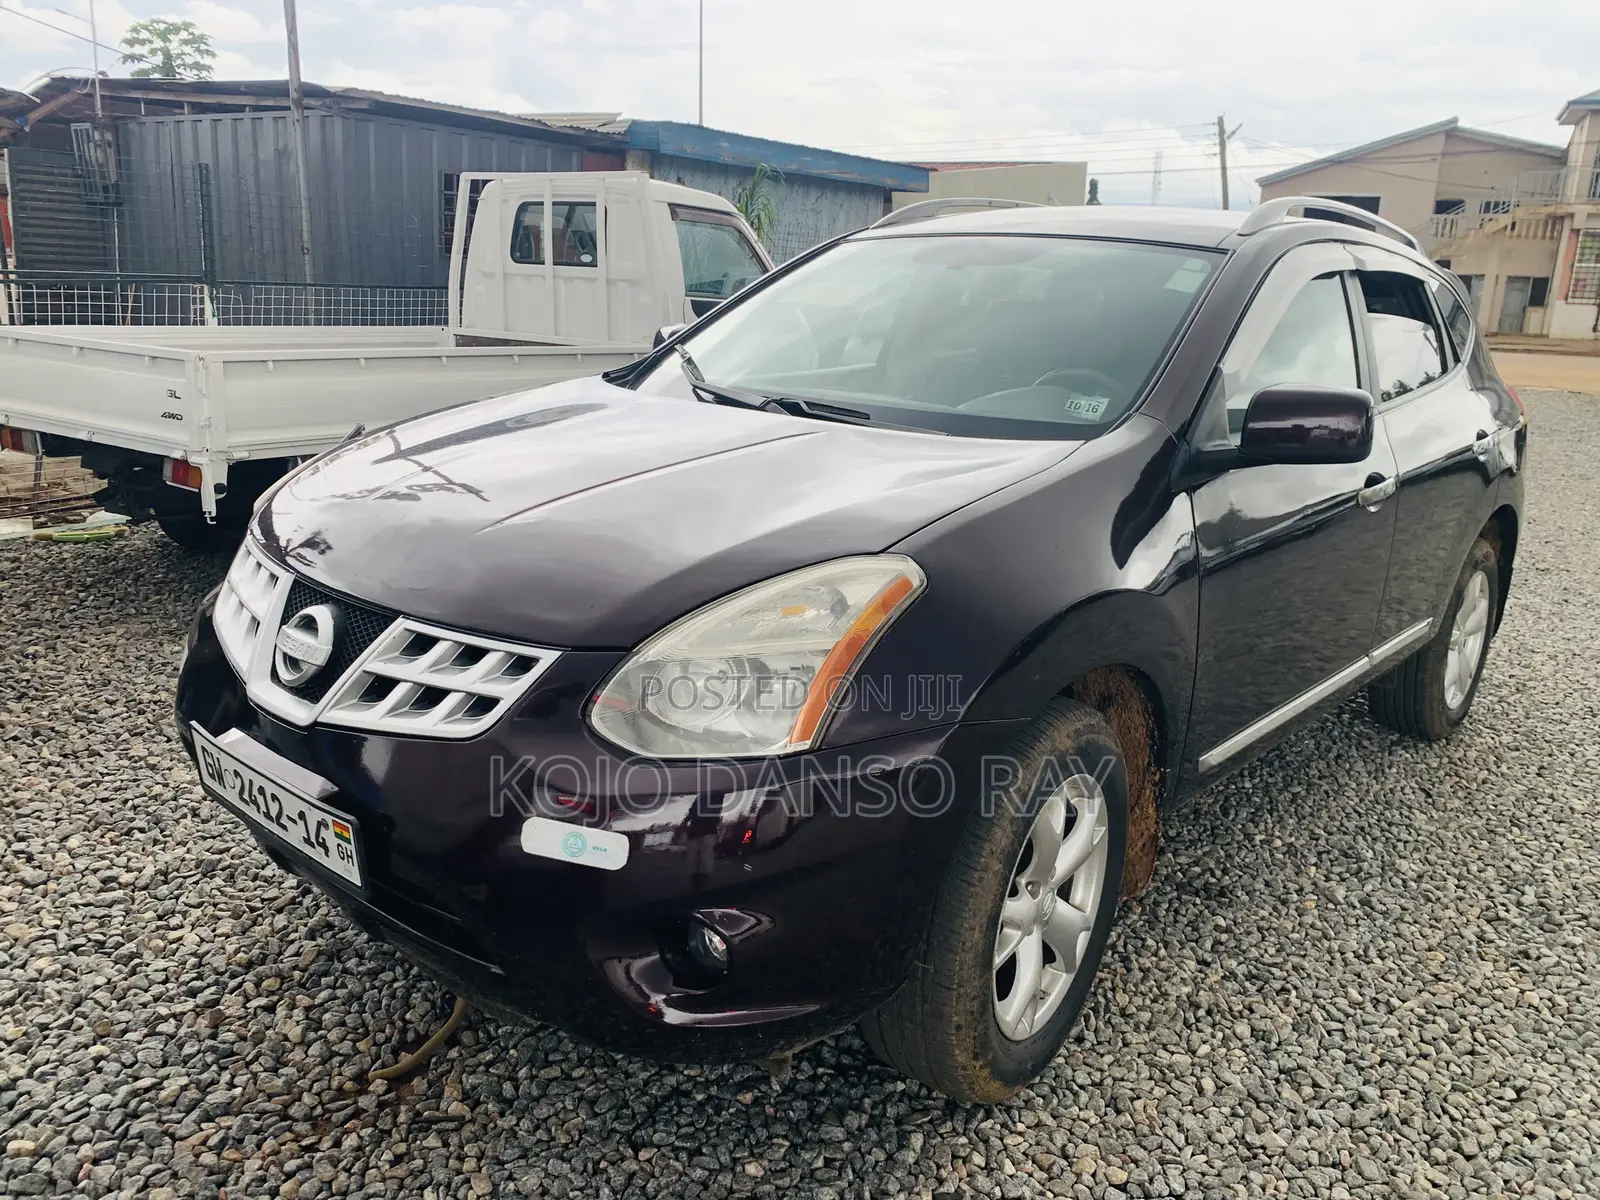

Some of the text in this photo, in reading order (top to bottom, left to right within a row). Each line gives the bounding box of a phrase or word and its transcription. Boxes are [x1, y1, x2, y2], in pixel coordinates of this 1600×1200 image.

[161, 411, 183, 421] 4WD
[1067, 401, 1100, 413] 10 16
[200, 744, 331, 858] GW 2412-14
[336, 842, 355, 867] GH
